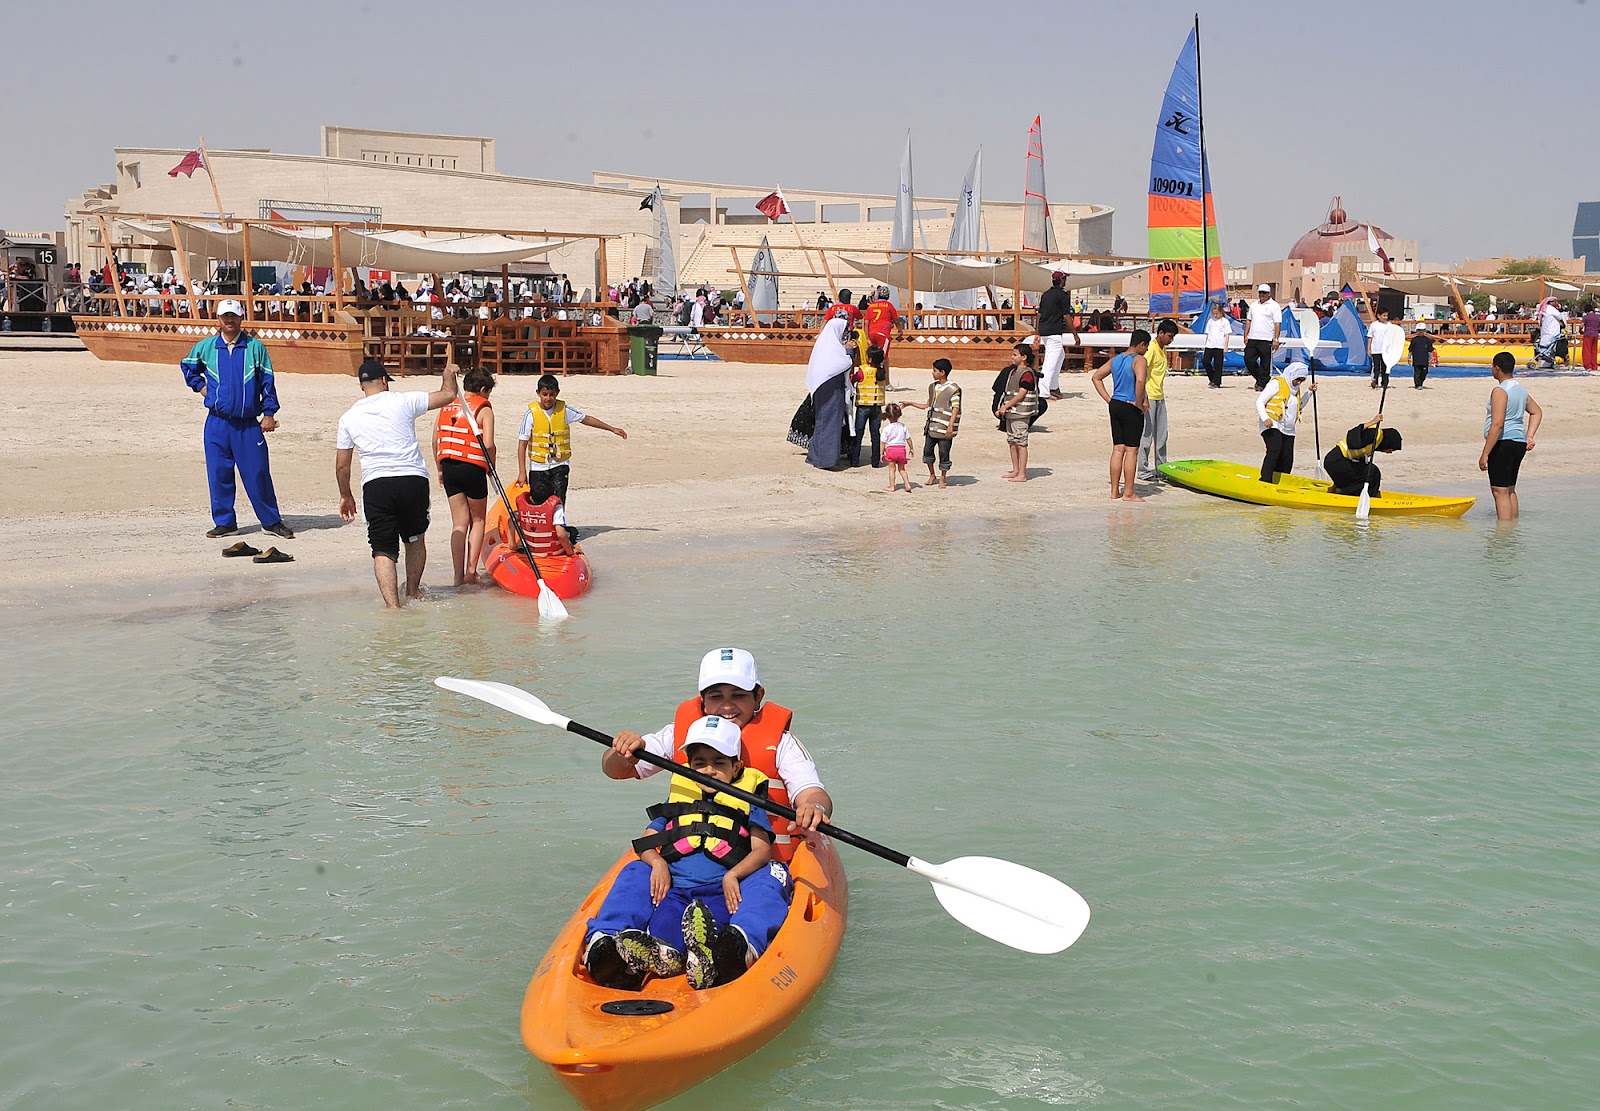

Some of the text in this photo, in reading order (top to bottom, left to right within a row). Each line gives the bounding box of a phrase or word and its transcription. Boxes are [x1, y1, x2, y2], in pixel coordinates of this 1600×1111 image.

[1152, 177, 1193, 196] 109091
[39, 250, 53, 264] 15
[873, 309, 881, 322] 7
[770, 964, 799, 991] FLOW
